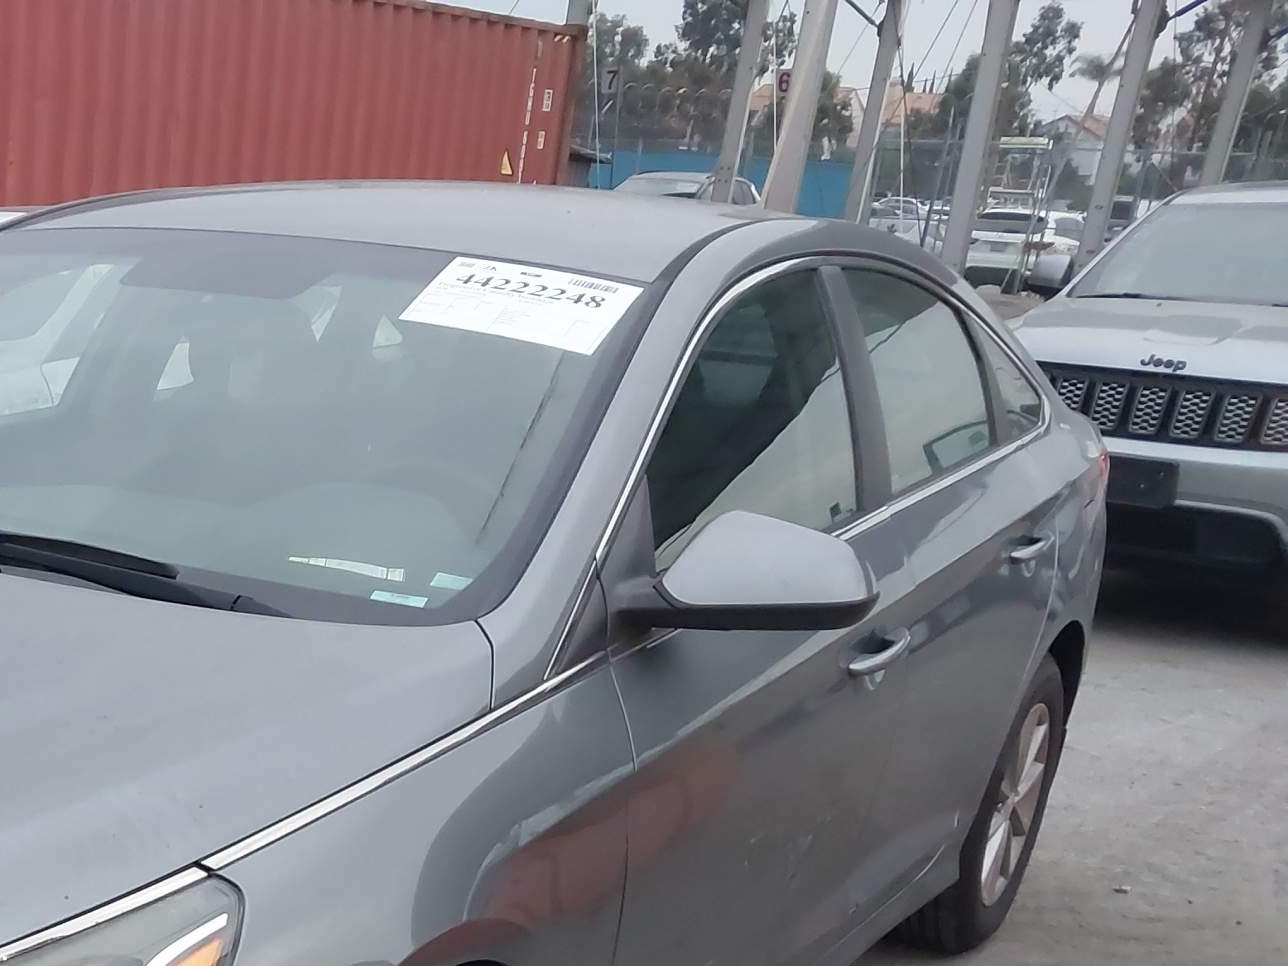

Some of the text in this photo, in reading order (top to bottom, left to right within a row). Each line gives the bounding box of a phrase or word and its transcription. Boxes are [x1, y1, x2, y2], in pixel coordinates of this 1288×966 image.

[606, 69, 618, 91] 7
[778, 71, 791, 93] 6
[455, 273, 607, 309] 44222248
[1140, 354, 1187, 372] Jeep
